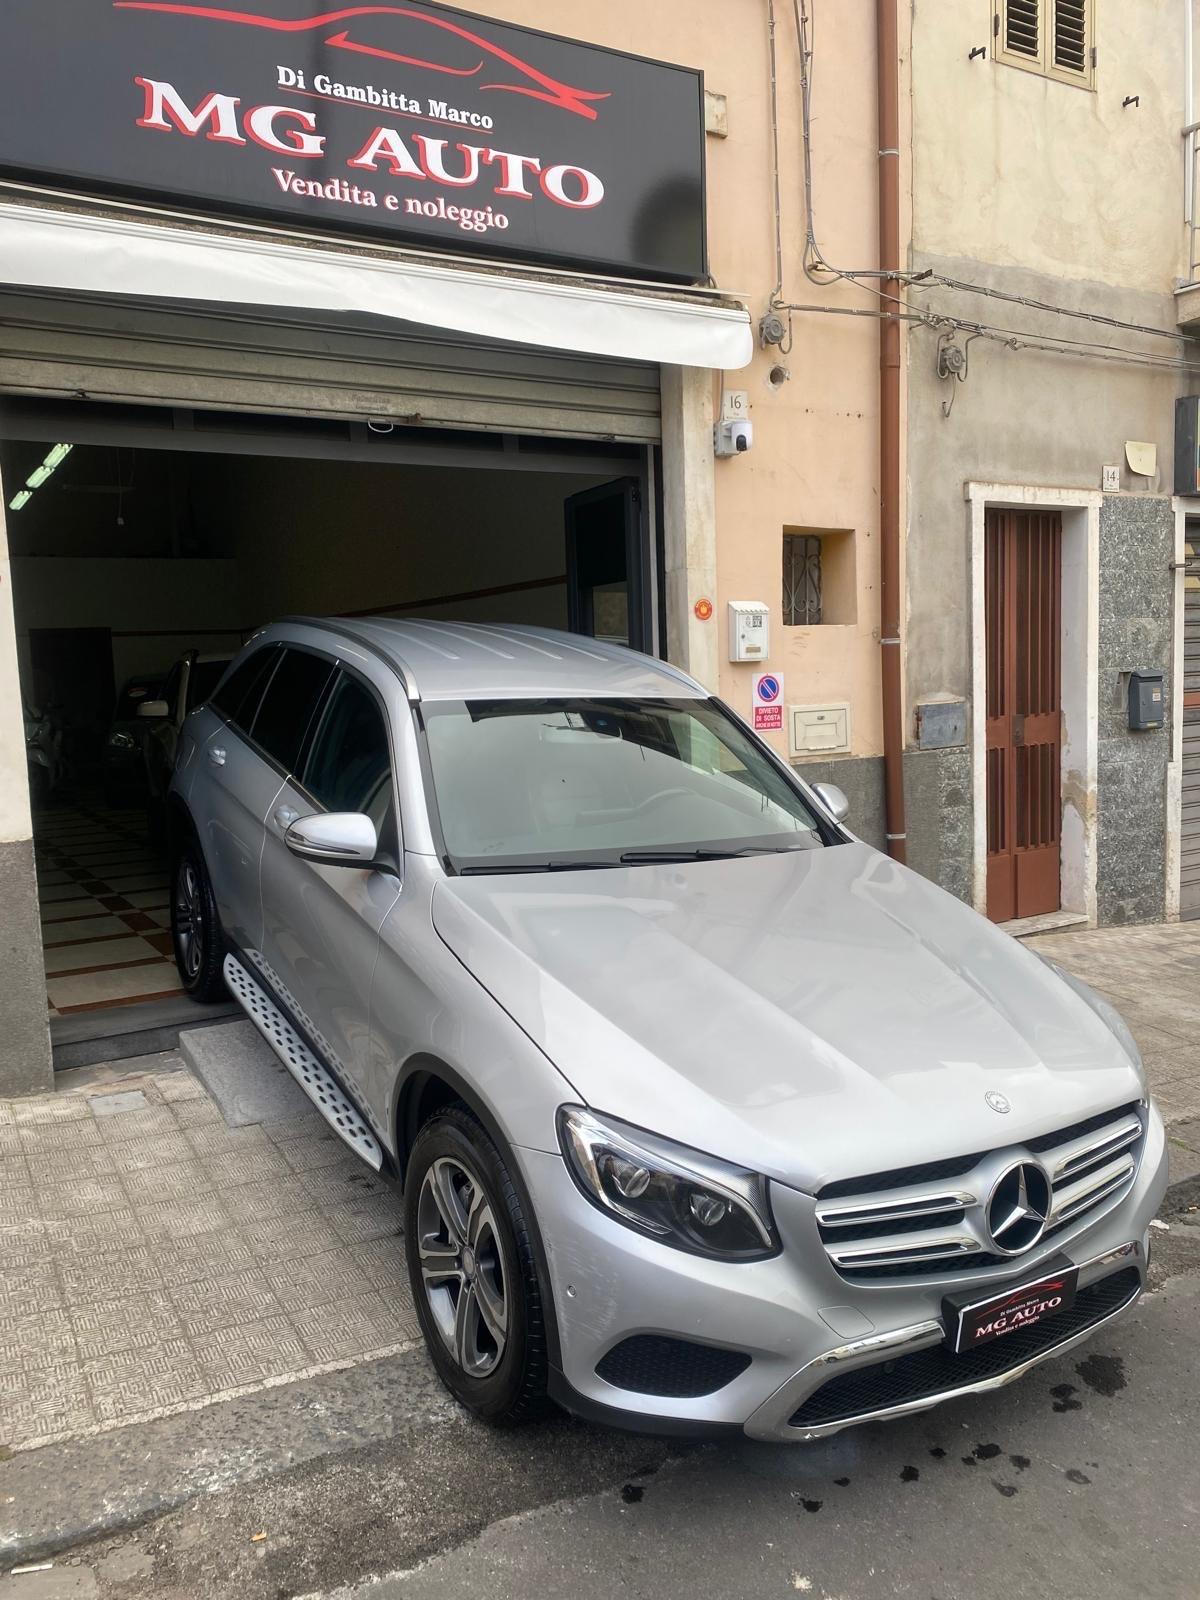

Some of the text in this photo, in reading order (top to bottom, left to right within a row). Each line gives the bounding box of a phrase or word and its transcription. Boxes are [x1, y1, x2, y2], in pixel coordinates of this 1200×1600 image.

[276, 65, 494, 130] Di Gambitta Marco
[134, 75, 605, 209] MG AUTO
[271, 167, 510, 233] Vendita e noleggio
[730, 394, 742, 409] 16
[758, 707, 779, 715] DIVIETO
[763, 714, 781, 722] SOSTA
[975, 1296, 1062, 1338] MG AUTO
